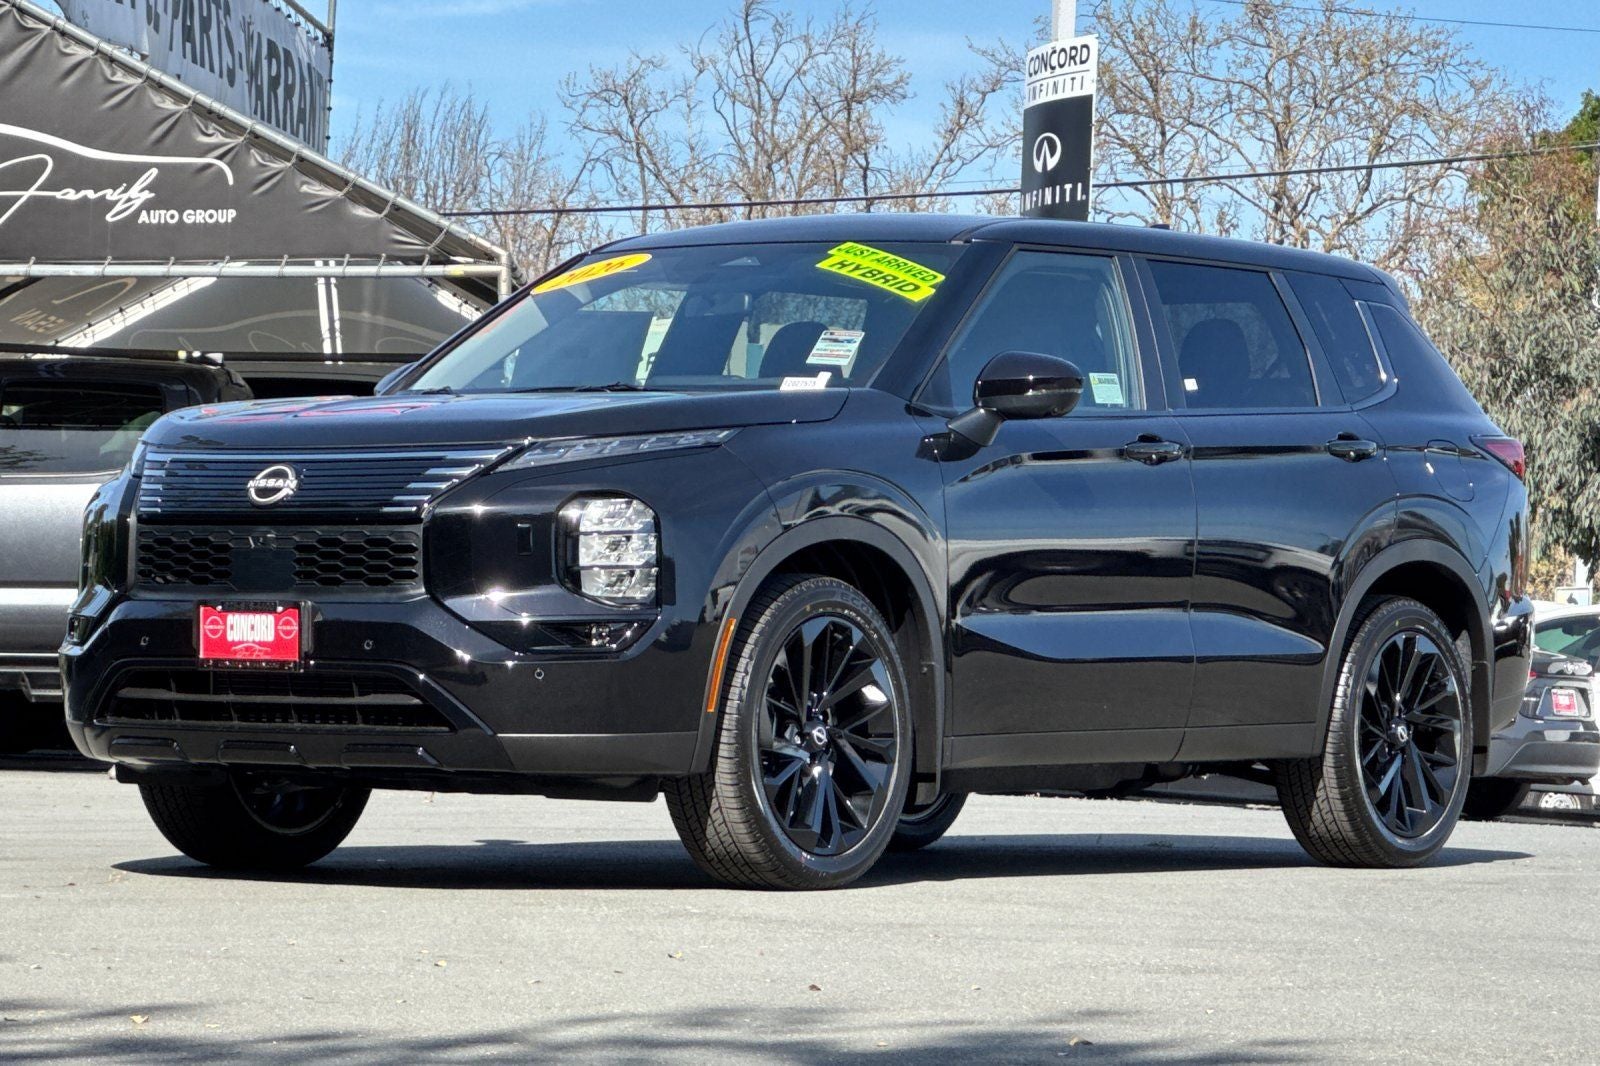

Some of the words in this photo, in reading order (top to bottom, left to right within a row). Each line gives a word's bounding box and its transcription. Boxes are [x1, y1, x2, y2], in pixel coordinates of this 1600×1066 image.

[1028, 43, 1090, 78] CONCORD
[1028, 75, 1084, 103] INFINITI
[138, 209, 179, 224] AUTO
[182, 208, 237, 224] GROUP
[828, 259, 920, 293] HYBRID
[837, 245, 879, 259] JUST
[872, 255, 938, 282] ARRIVED
[247, 478, 298, 489] NISSAN
[226, 614, 275, 642] CONCORD
